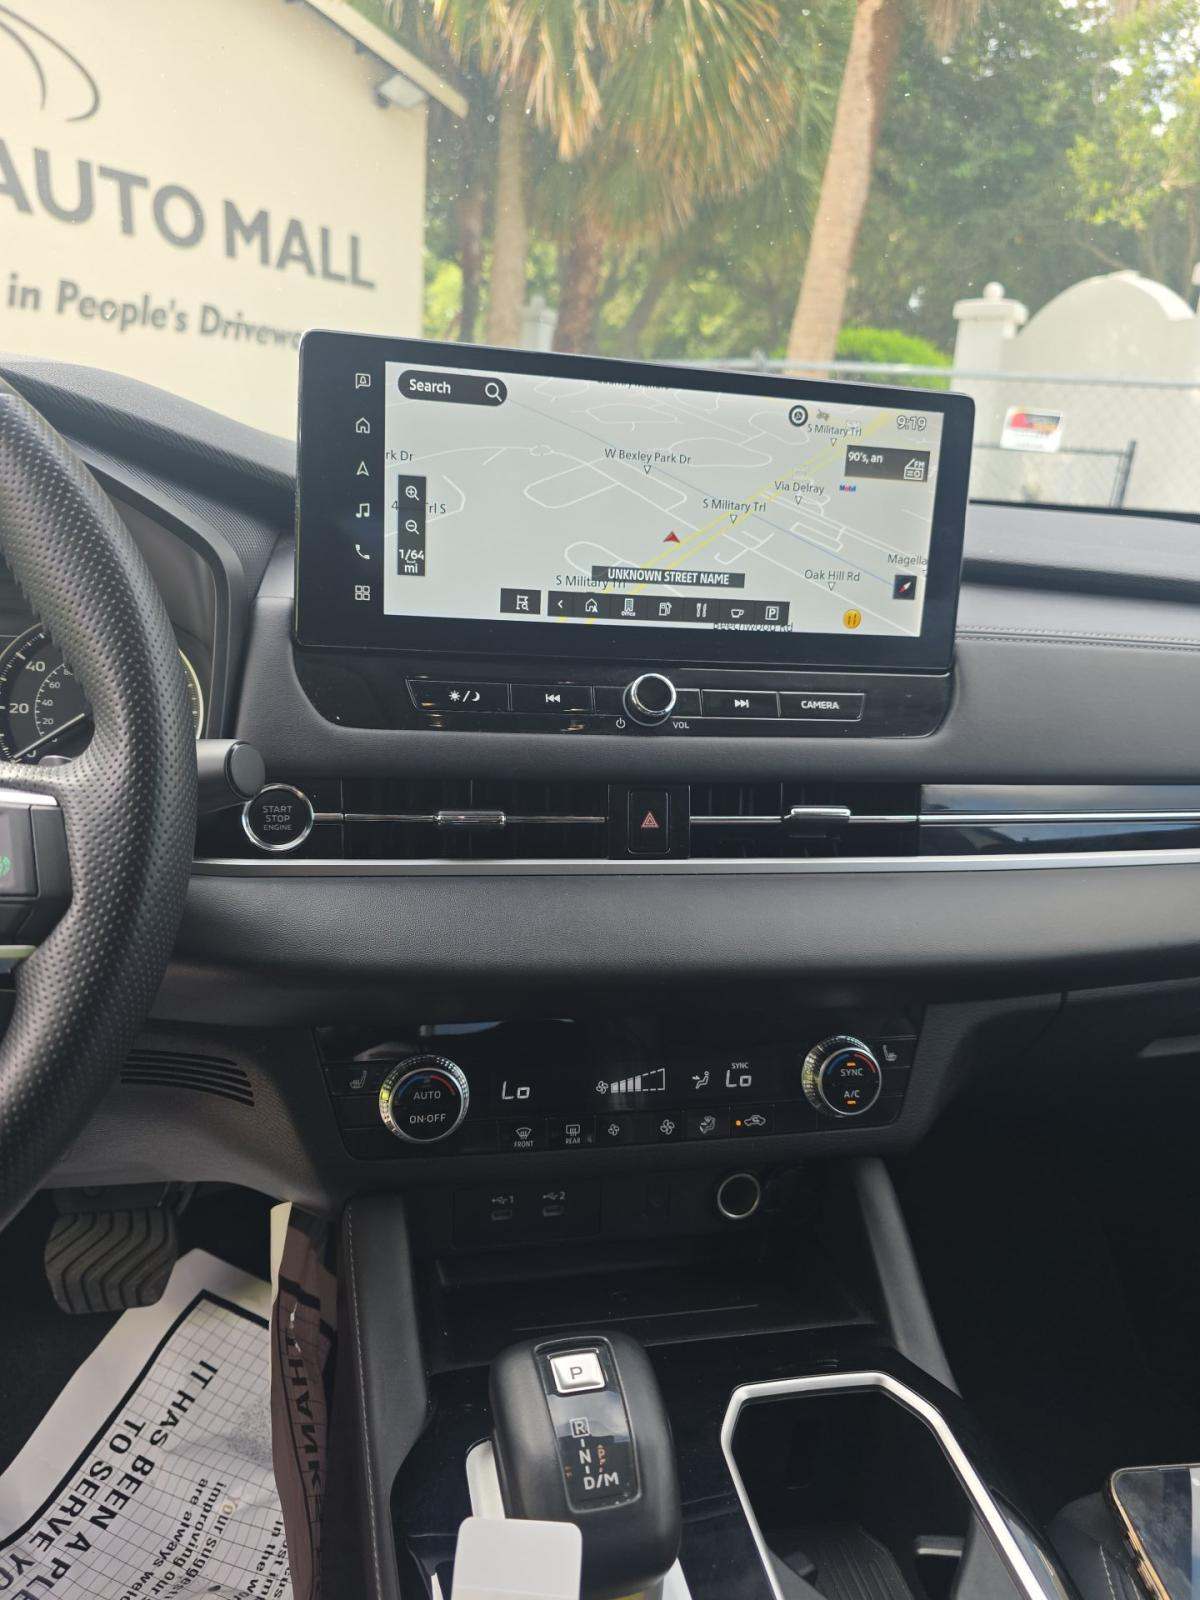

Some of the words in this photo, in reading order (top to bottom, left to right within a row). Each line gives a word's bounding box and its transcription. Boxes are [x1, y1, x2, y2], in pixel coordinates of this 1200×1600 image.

[223, 199, 376, 290] MALL
[7, 272, 41, 311] in
[56, 279, 188, 332] People's
[409, 378, 451, 395] Search
[896, 415, 927, 431] 9:19
[815, 425, 848, 437] Military
[401, 451, 414, 461] Dr
[604, 448, 617, 458] W
[619, 449, 652, 463] Bexley
[654, 452, 676, 463] Park
[679, 454, 692, 464] Dr
[870, 454, 883, 463] an
[774, 480, 790, 492] Via
[792, 482, 825, 496] Delray
[702, 498, 709, 509] S
[711, 499, 750, 512] Military
[753, 501, 766, 512] Trl
[399, 549, 424, 560] 1/64
[404, 563, 418, 574] mi
[804, 569, 825, 581] Oak
[828, 570, 845, 582] Hill
[847, 571, 860, 582] Rd
[556, 574, 562, 585] S
[565, 575, 608, 590] Military
[608, 568, 661, 581] UNKNOWN
[664, 570, 698, 583] STREET
[700, 572, 730, 585] NAME
[25, 661, 46, 672] 40
[49, 681, 61, 689] 60
[9, 703, 30, 714] 20
[41, 699, 53, 707] 40
[801, 700, 840, 710] CAMERA
[672, 721, 690, 729] VOL
[262, 805, 292, 813] START
[265, 814, 290, 822] STOP
[731, 1062, 749, 1070] SYNC
[840, 1068, 863, 1077] SYNC
[725, 1069, 752, 1088] Lo
[413, 1090, 441, 1101] AUTO
[502, 1080, 531, 1101] Lo
[844, 1089, 860, 1099] A/C
[190, 1360, 219, 1390] IT
[570, 1366, 583, 1379] P
[149, 1390, 196, 1447] HAS
[575, 1421, 586, 1435] R
[109, 1419, 146, 1454] TO
[579, 1449, 591, 1464] N
[583, 1471, 619, 1490] D/M
[89, 1455, 155, 1530] BEEN
[190, 1478, 208, 1506] are
[28, 1460, 113, 1552] SERVE
[173, 1482, 227, 1568] improving
[64, 1531, 92, 1552] A
[152, 1511, 192, 1567] always
[151, 1571, 175, 1595] our
